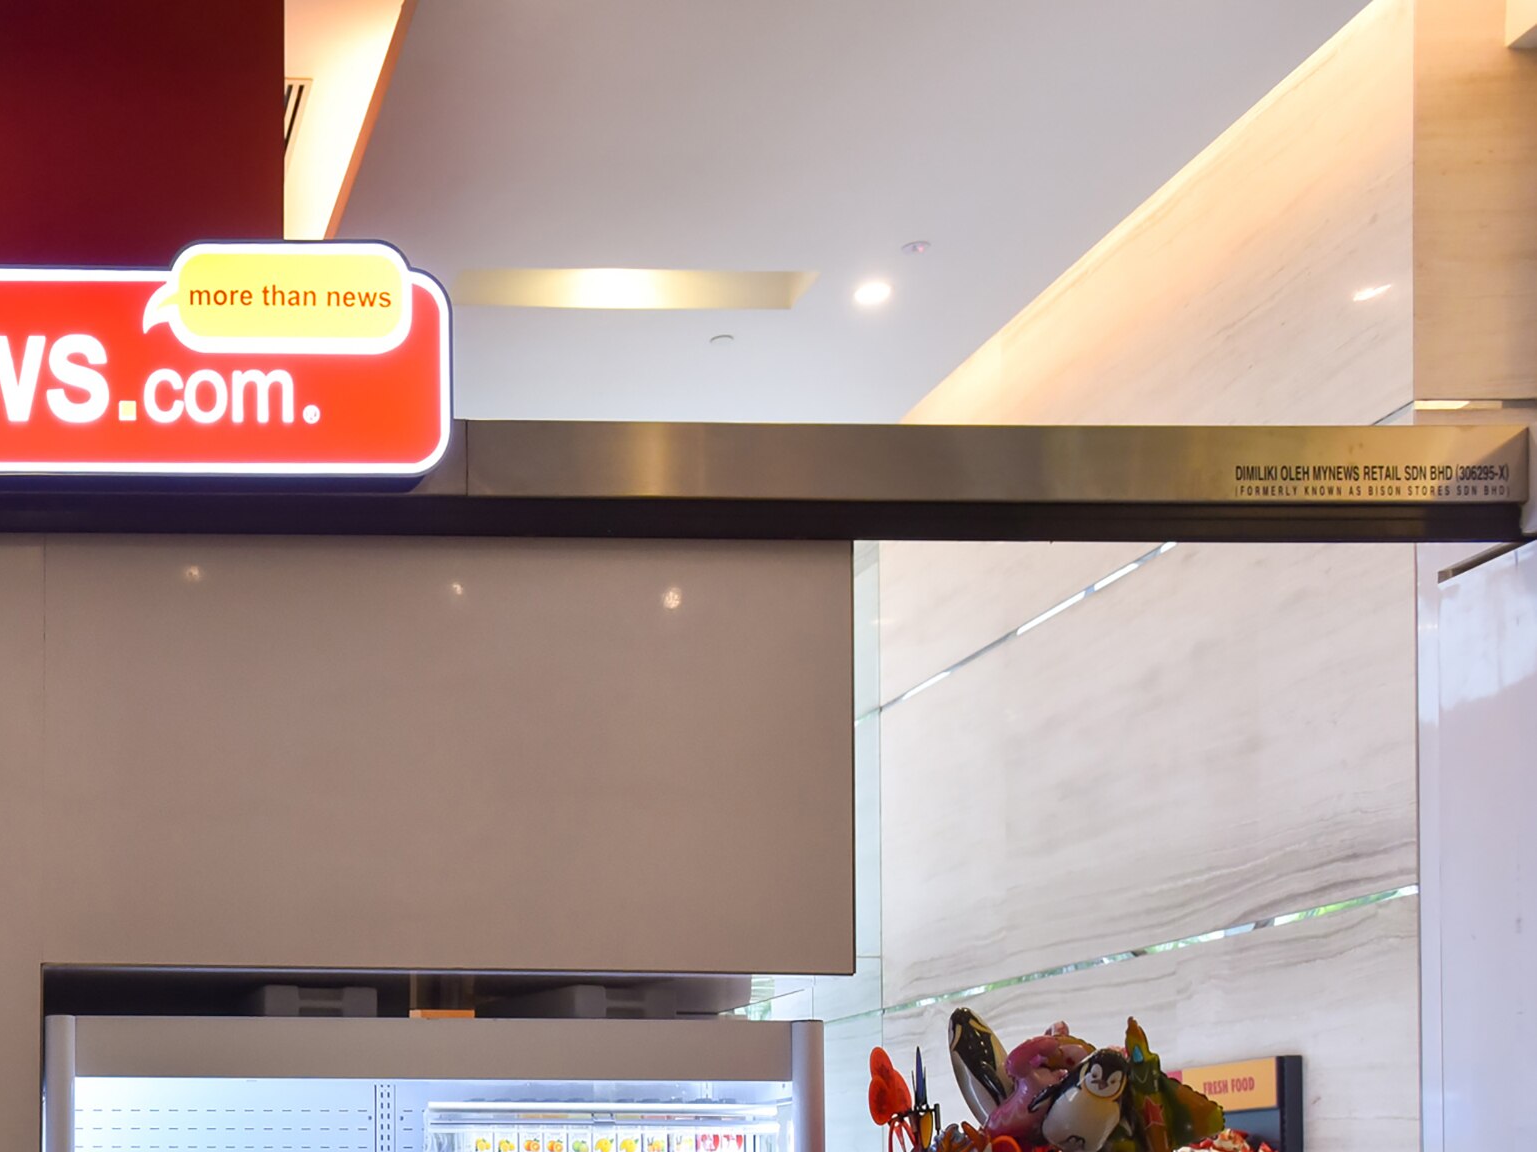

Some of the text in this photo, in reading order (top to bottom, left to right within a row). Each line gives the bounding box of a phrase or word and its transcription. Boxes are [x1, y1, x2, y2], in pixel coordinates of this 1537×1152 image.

[189, 284, 392, 308] more than news
[1235, 465, 1278, 481] DIMILIKI
[1281, 465, 1310, 481] OLEH
[1313, 465, 1360, 481] MYNEWS
[1363, 465, 1401, 481] RETAIL
[1404, 465, 1427, 481] SDN
[1430, 465, 1453, 481] BHD
[1304, 485, 1342, 497] KNOWN
[1349, 485, 1361, 497] AS
[1368, 485, 1401, 497] BISON
[1408, 485, 1450, 497] STORES
[1203, 1076, 1255, 1096] FRESH FOOD
